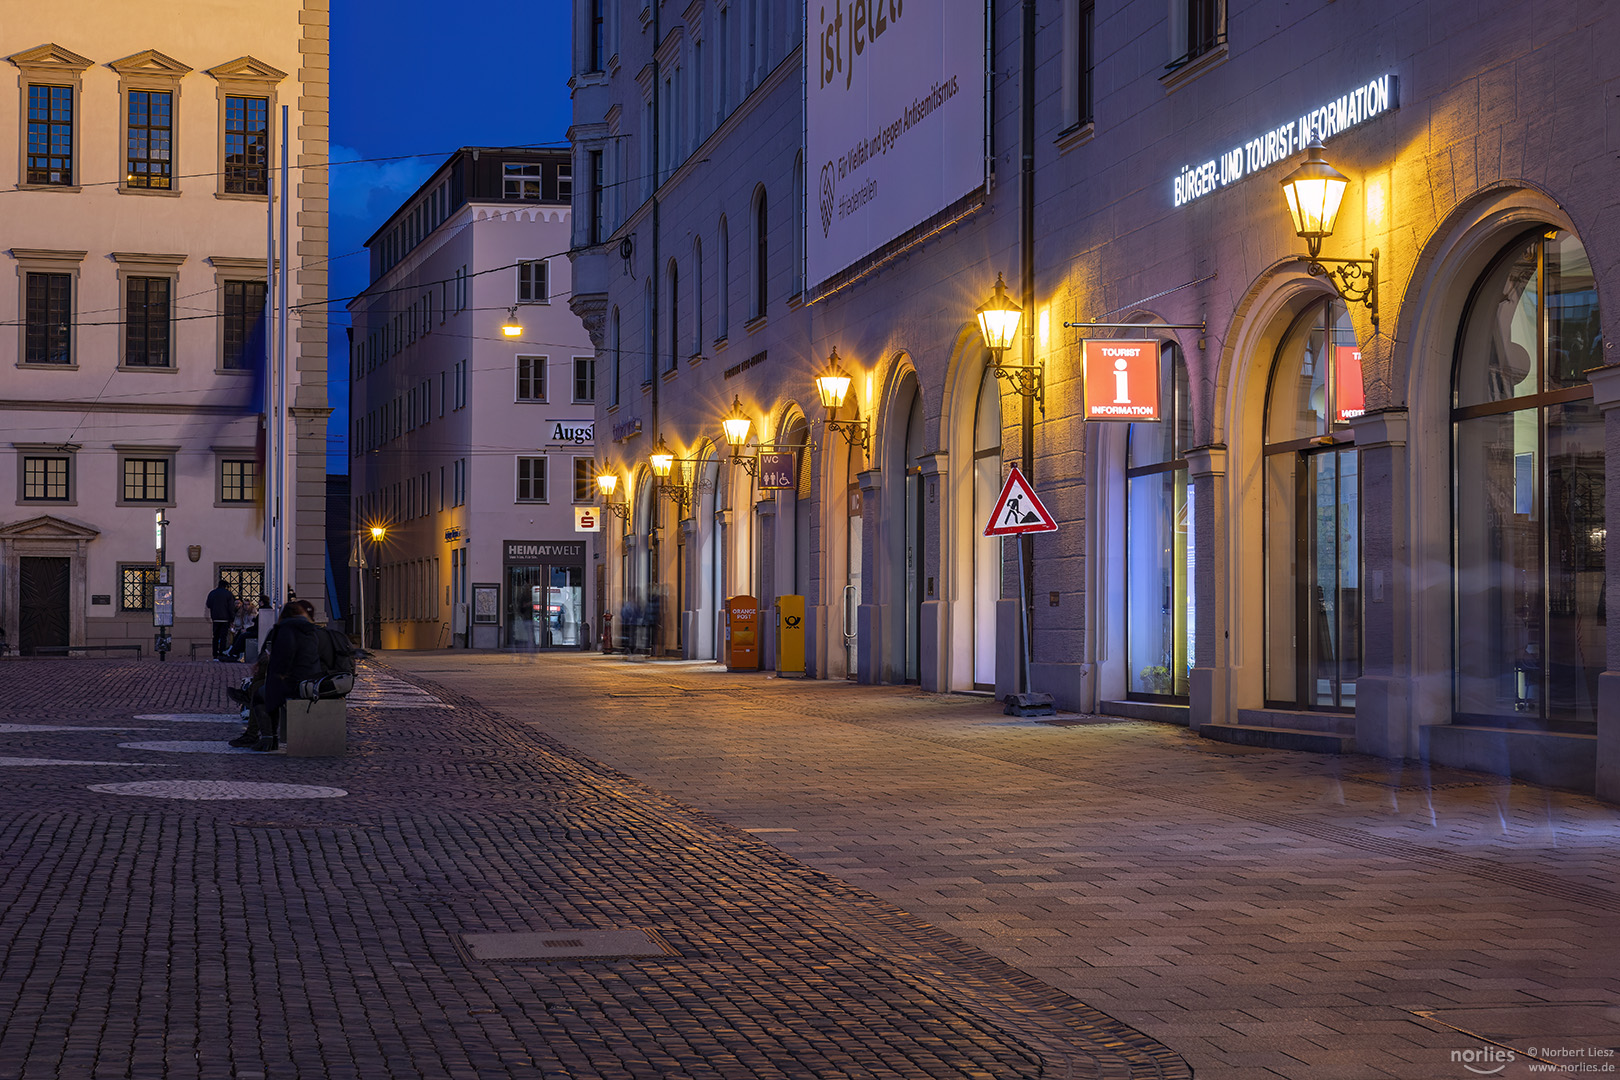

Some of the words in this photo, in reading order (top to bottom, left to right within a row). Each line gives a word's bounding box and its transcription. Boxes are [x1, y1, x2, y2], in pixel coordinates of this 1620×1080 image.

[820, 0, 843, 90] ist
[838, 155, 848, 181] Für
[848, 137, 869, 173] Vielfalt
[869, 126, 881, 157] und
[882, 117, 902, 155] gegen
[903, 74, 960, 133] Antisemitismus.
[1245, 74, 1389, 174] TOURIST-INFORMATION
[1101, 347, 1141, 357] TOURIST
[1091, 406, 1154, 416] INFORMATION
[552, 423, 595, 444] Augs
[762, 455, 779, 464] WC
[508, 545, 581, 555] HEIMATWELT
